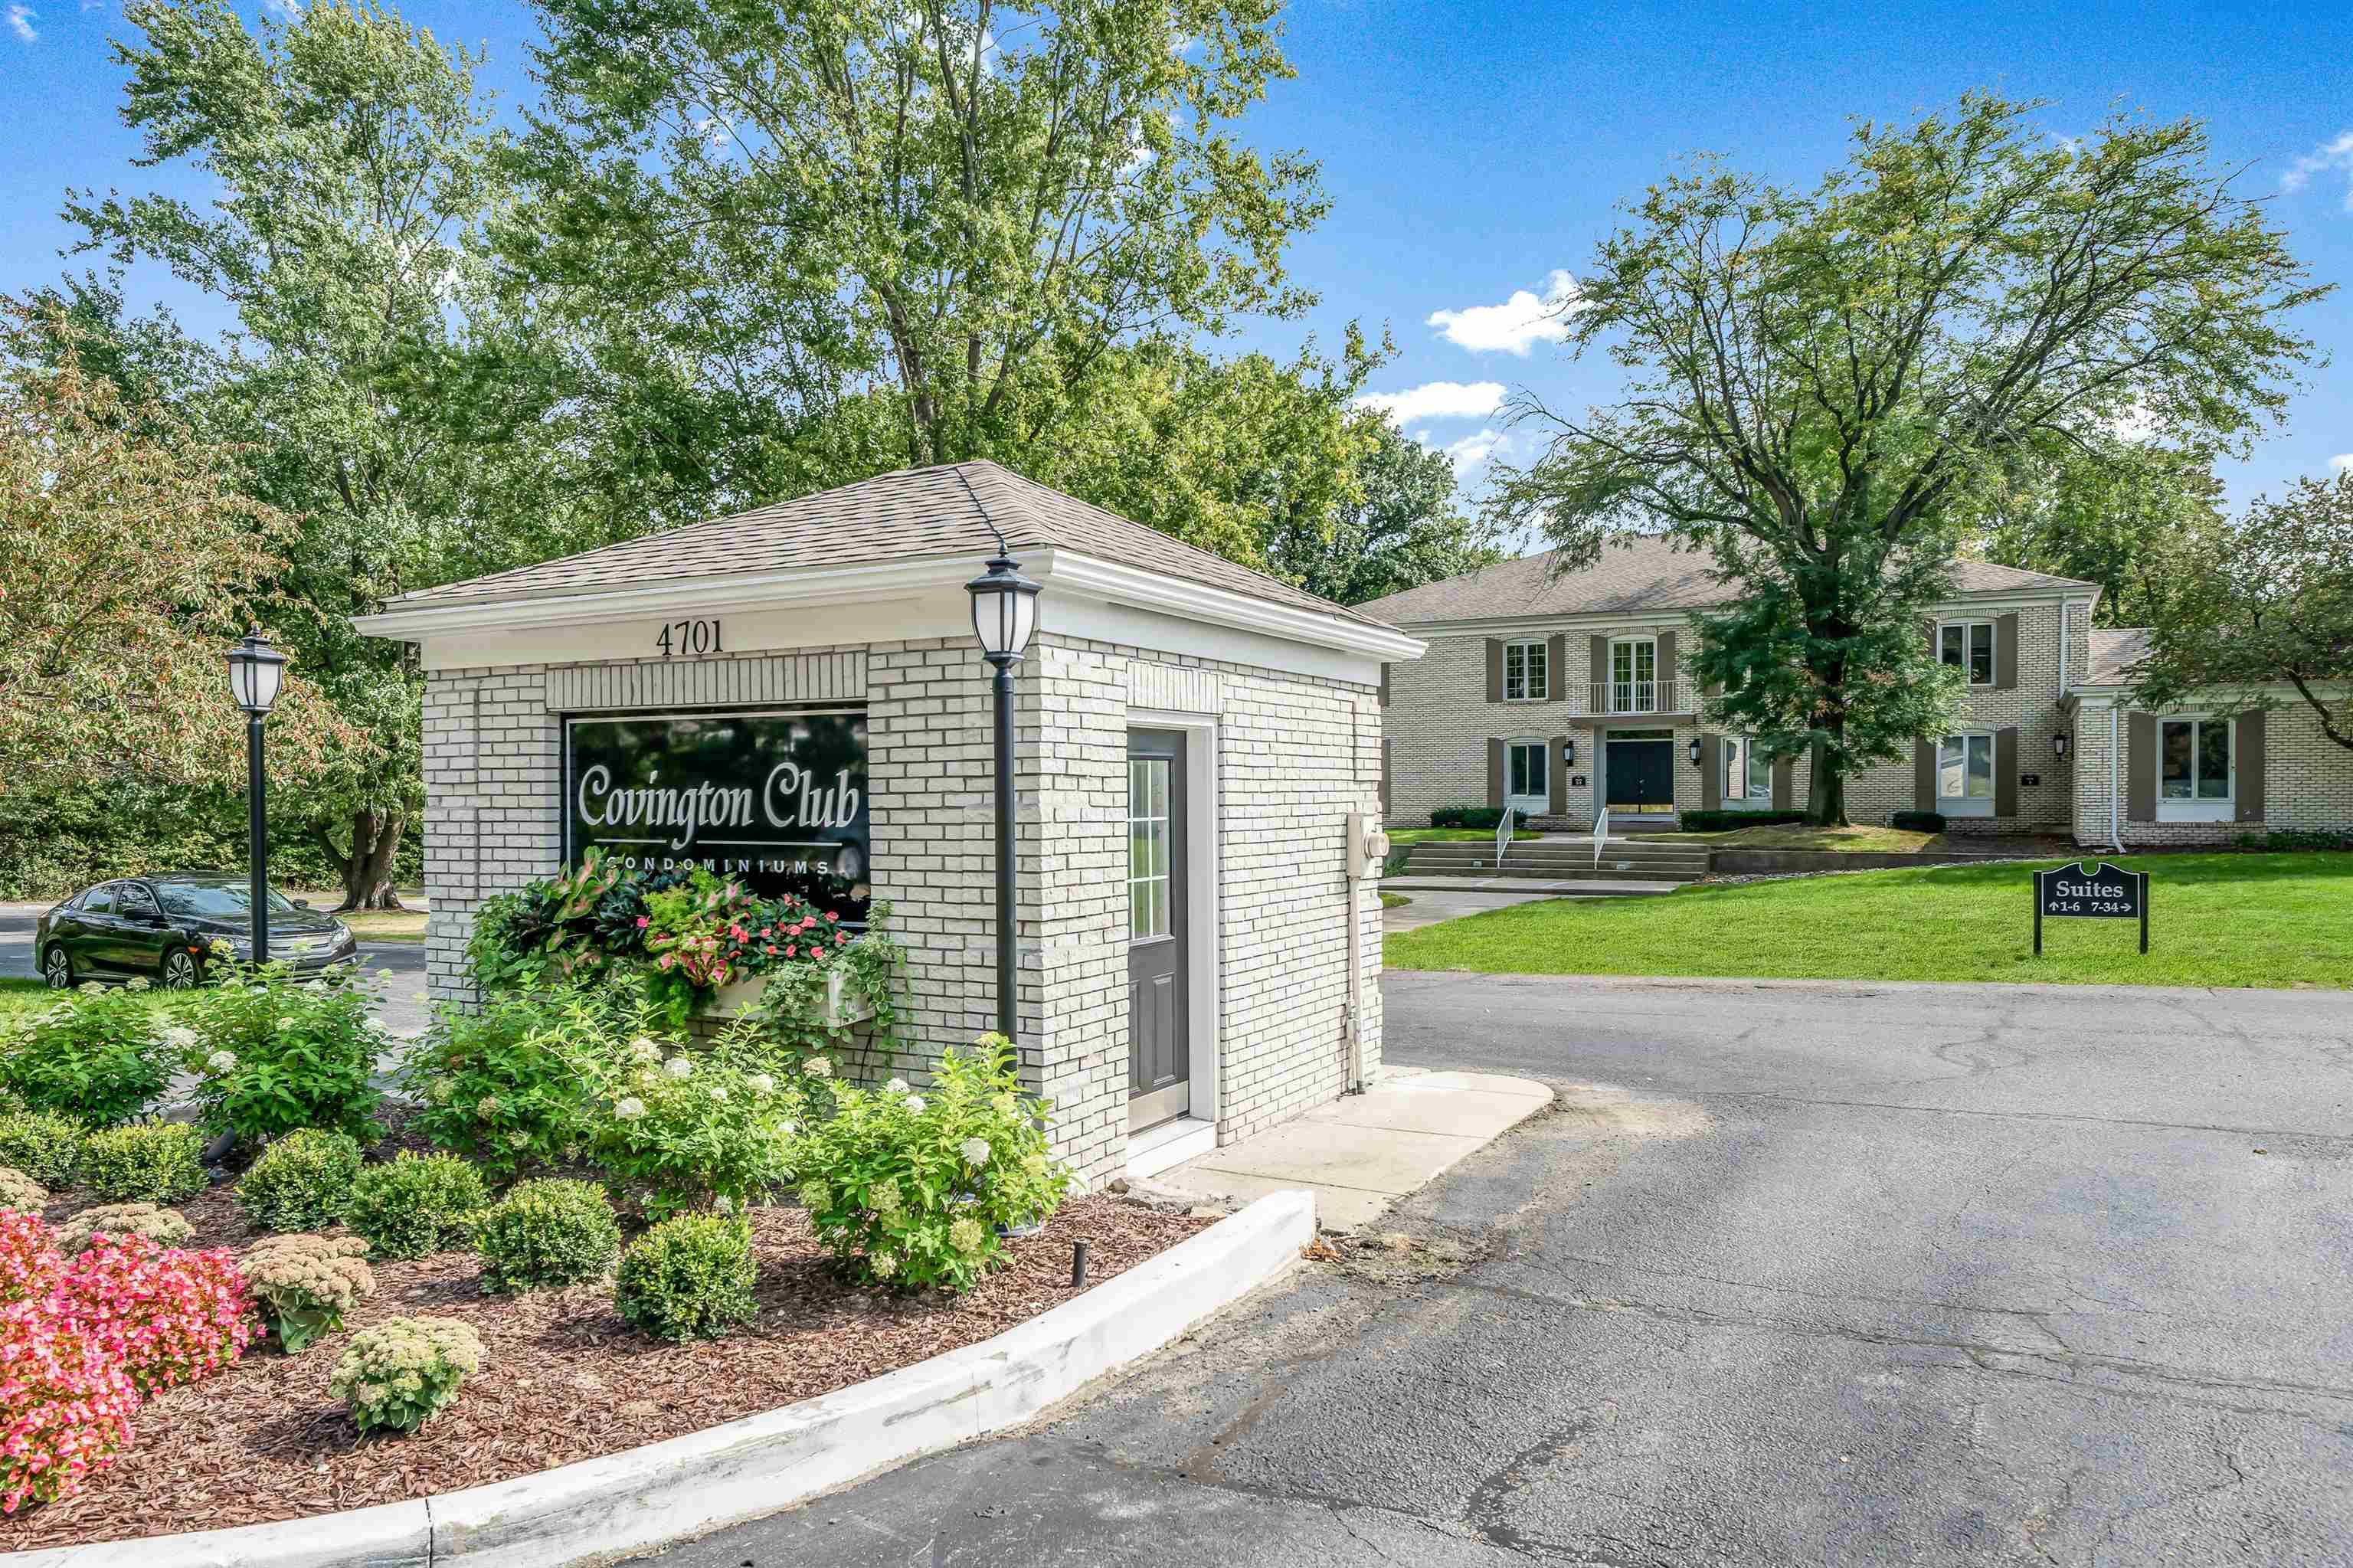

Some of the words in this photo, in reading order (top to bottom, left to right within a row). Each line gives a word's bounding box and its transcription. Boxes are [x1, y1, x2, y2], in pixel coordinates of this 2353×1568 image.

[656, 620, 723, 656] 4701
[578, 764, 754, 850] Covington
[764, 761, 859, 828] Club
[2056, 881, 2124, 897] Suites
[2060, 902, 2080, 912] 1-6
[2091, 902, 2119, 912] 7-34
